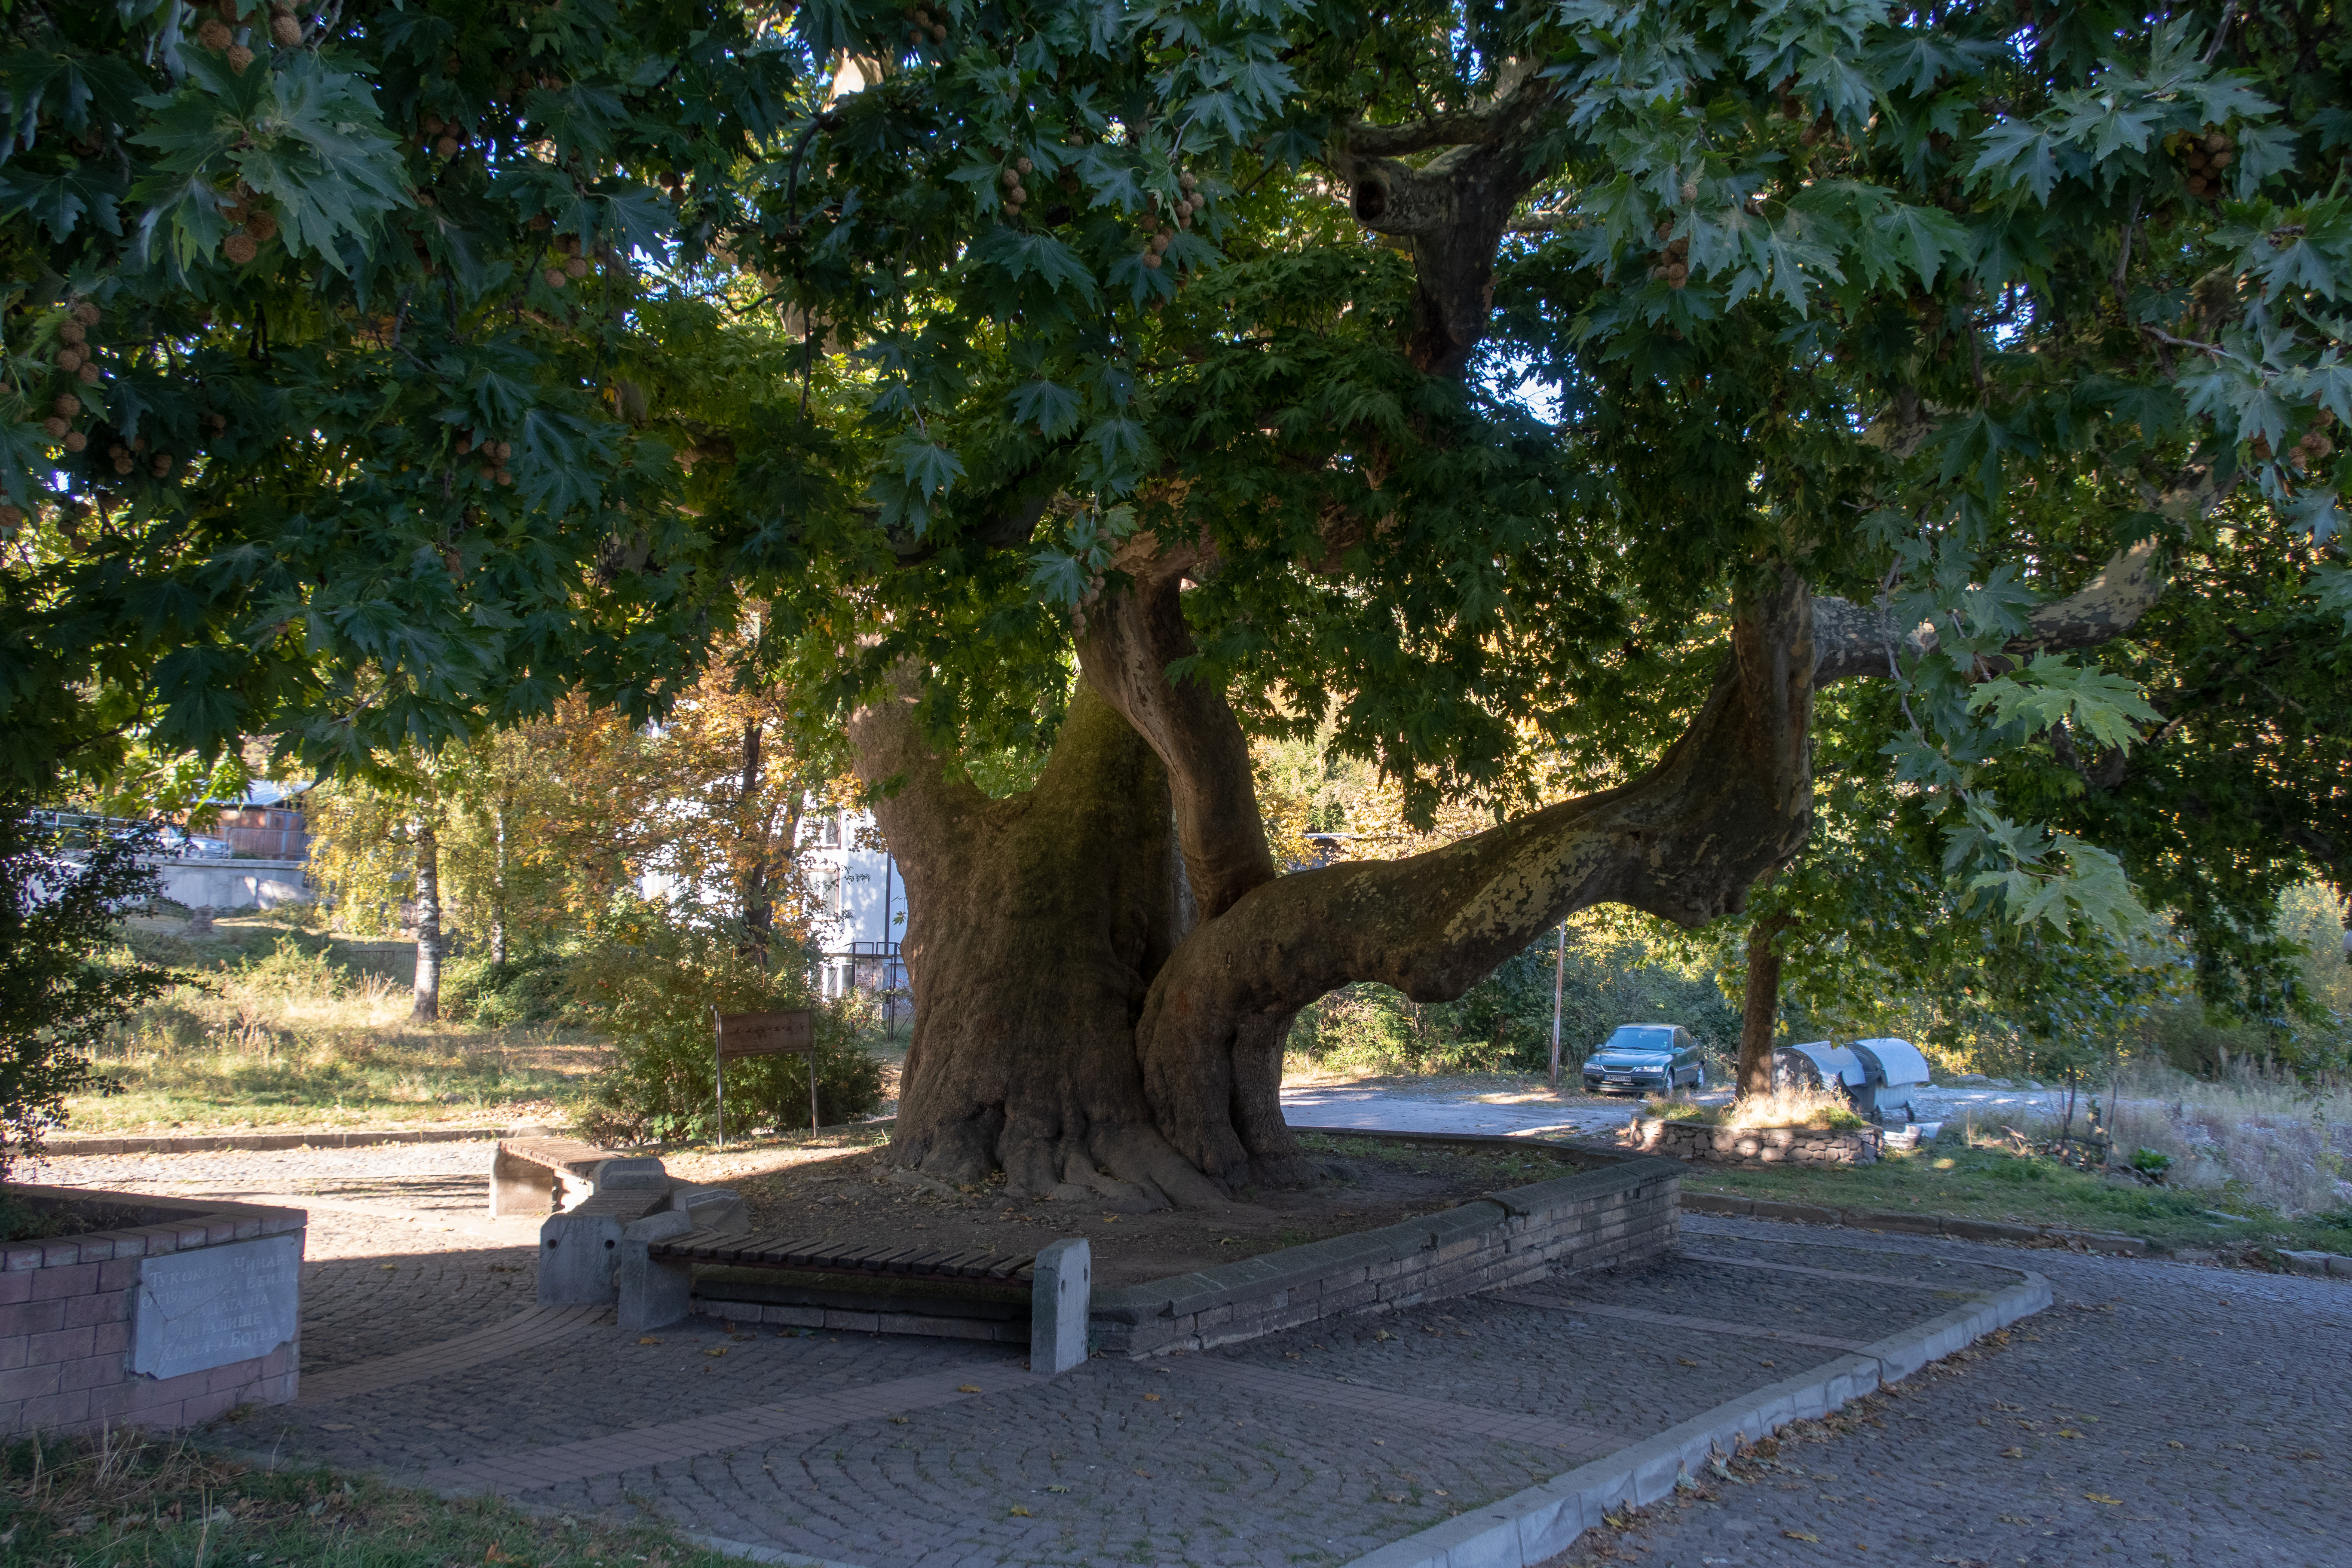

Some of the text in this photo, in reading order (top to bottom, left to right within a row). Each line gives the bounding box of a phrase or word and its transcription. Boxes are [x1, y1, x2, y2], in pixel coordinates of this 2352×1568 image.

[149, 1271, 179, 1288] ТУК
[182, 1263, 232, 1282] ОКОЛО
[141, 1293, 164, 1309] ОТ
[246, 1277, 256, 1289] Е
[249, 1293, 269, 1308] НА
[229, 1326, 278, 1348] БОТЕВ
